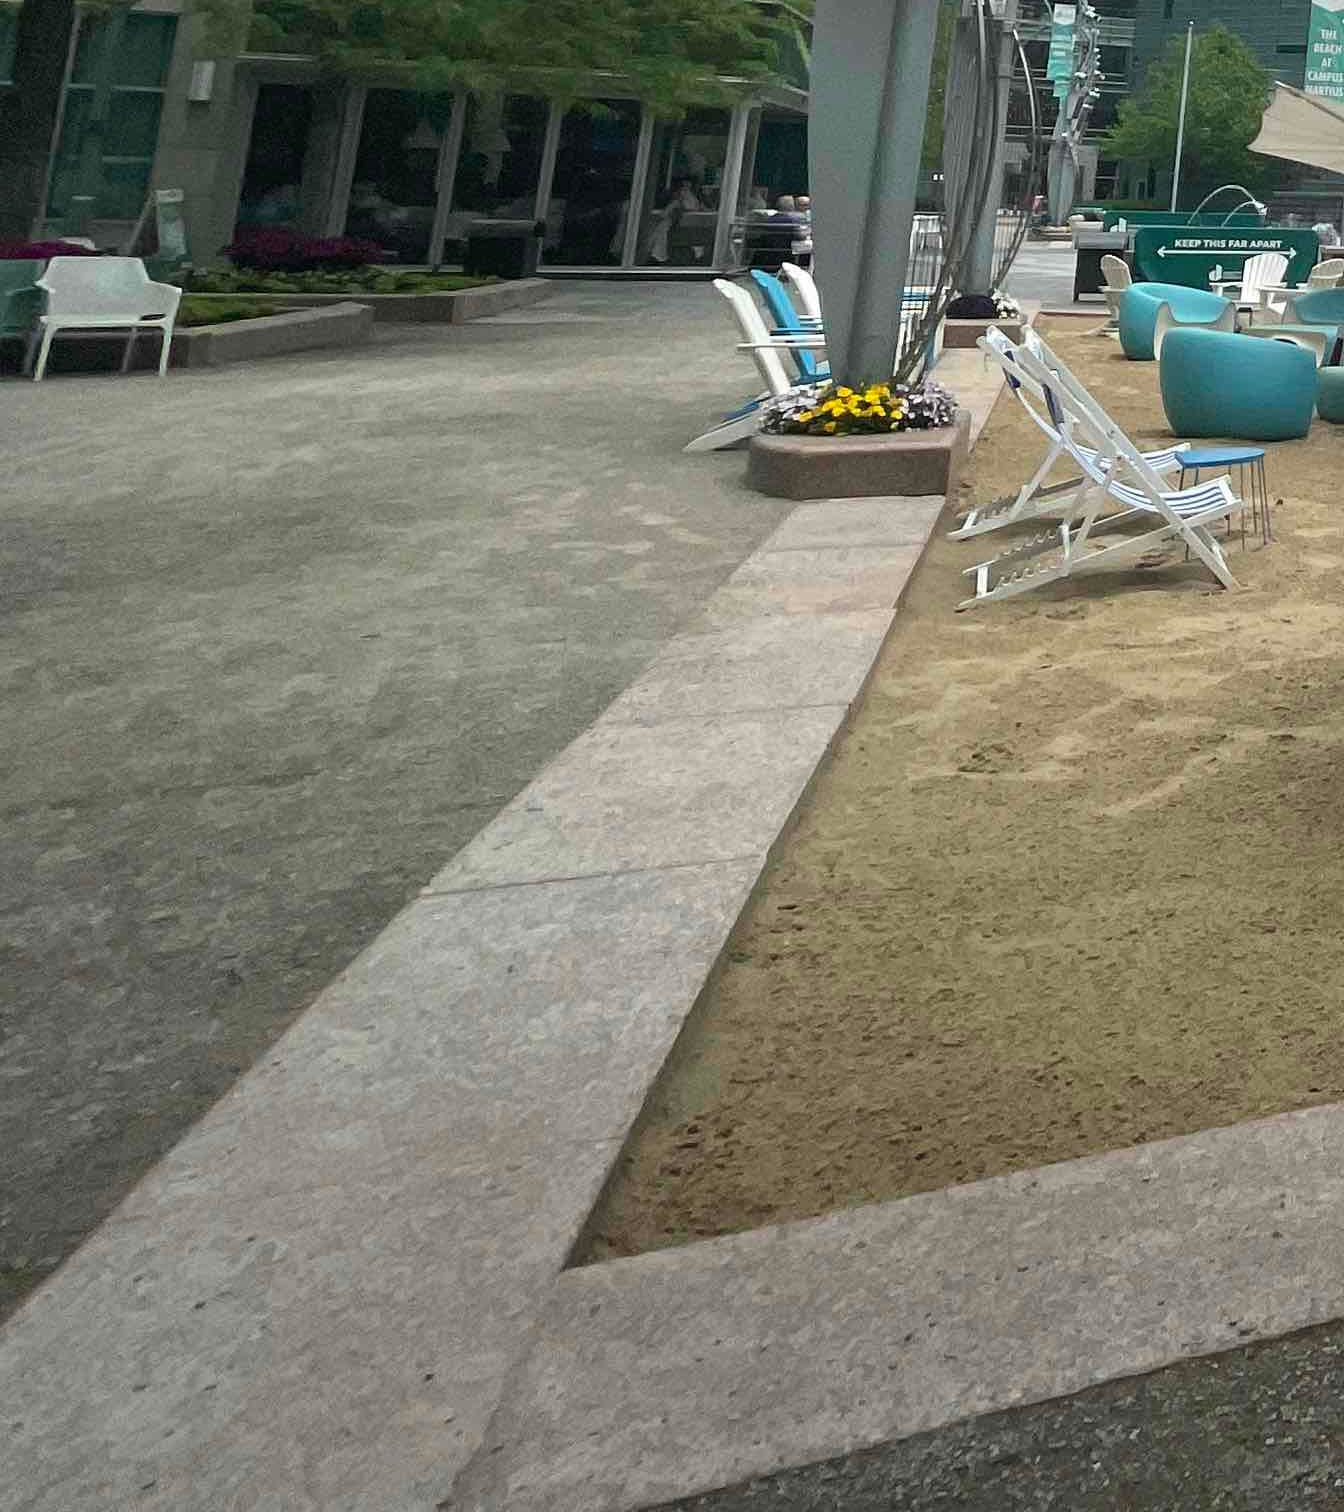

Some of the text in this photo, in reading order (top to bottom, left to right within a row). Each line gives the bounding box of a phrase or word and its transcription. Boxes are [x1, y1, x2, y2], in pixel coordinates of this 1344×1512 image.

[1174, 239, 1282, 249] KEEP THIS FAR APART
